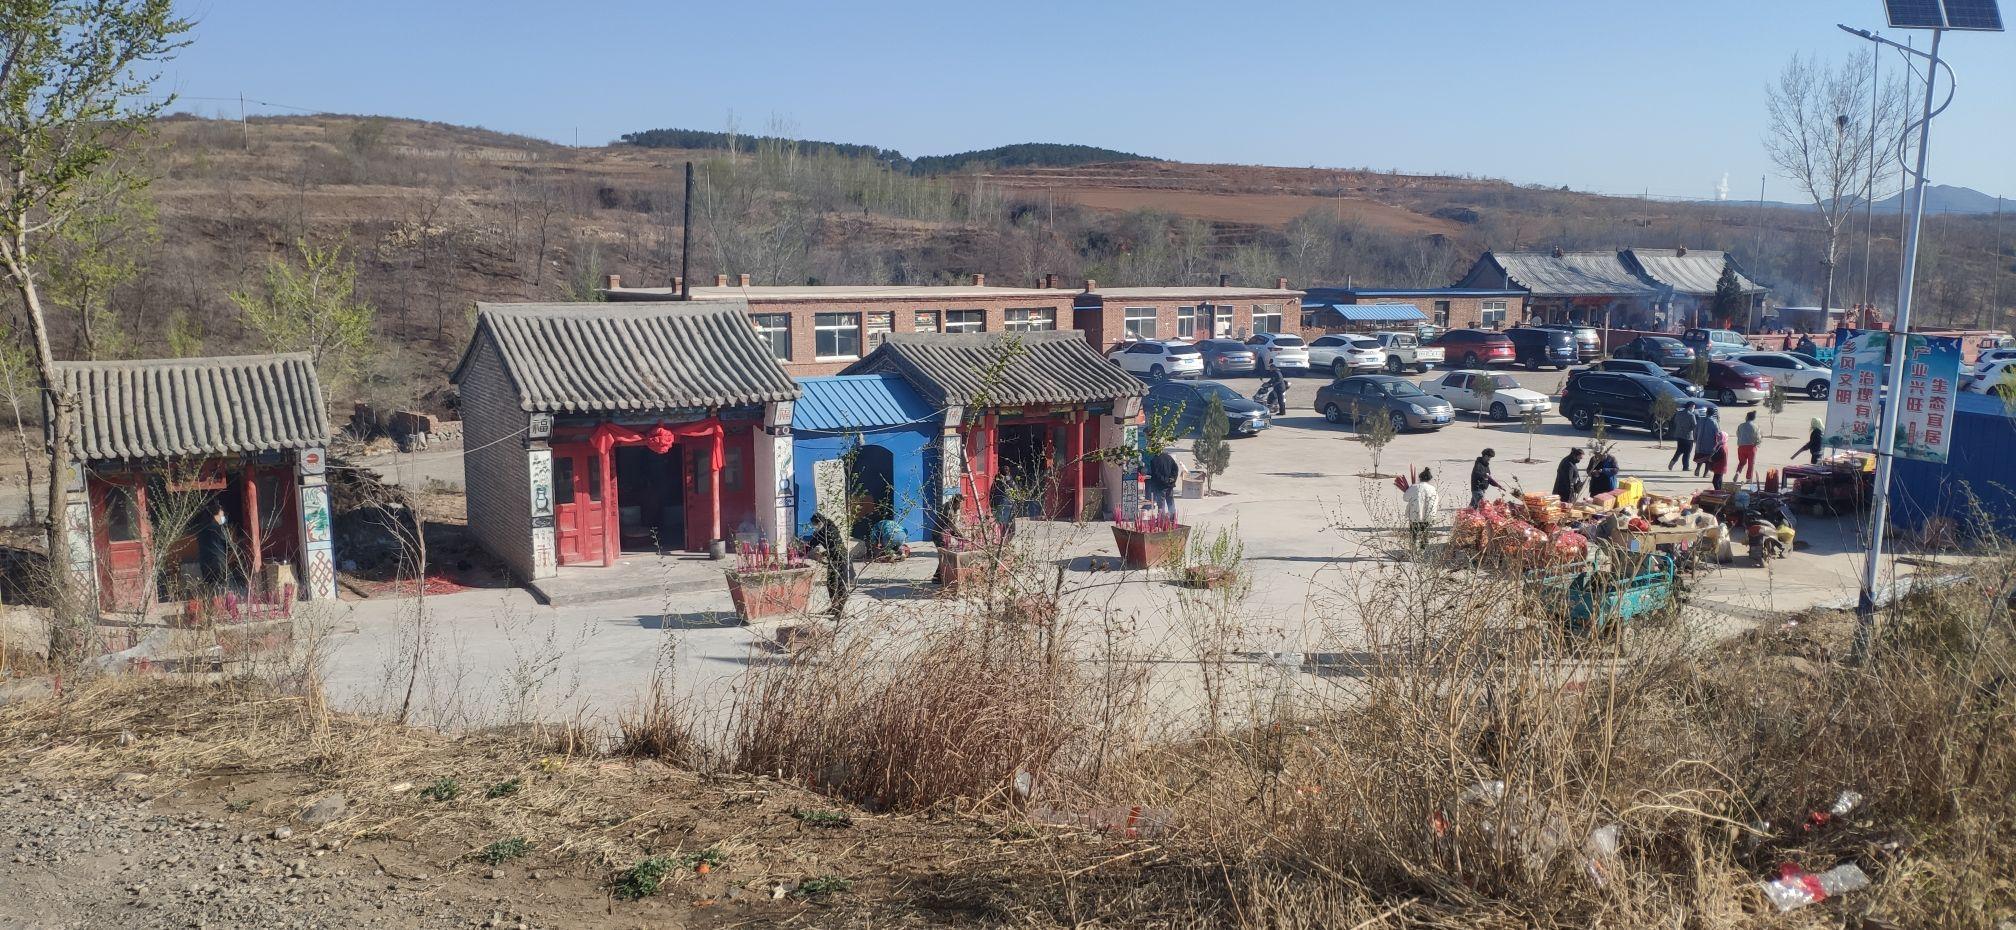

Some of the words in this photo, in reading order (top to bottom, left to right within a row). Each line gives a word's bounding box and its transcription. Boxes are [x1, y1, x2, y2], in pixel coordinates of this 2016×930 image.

[1835, 340, 1858, 405] 乡风文明
[1852, 370, 1876, 436] 治理有效
[1906, 345, 1932, 413] 产业兴旺
[532, 418, 549, 434] 福
[1924, 377, 1949, 446] 生态宜居
